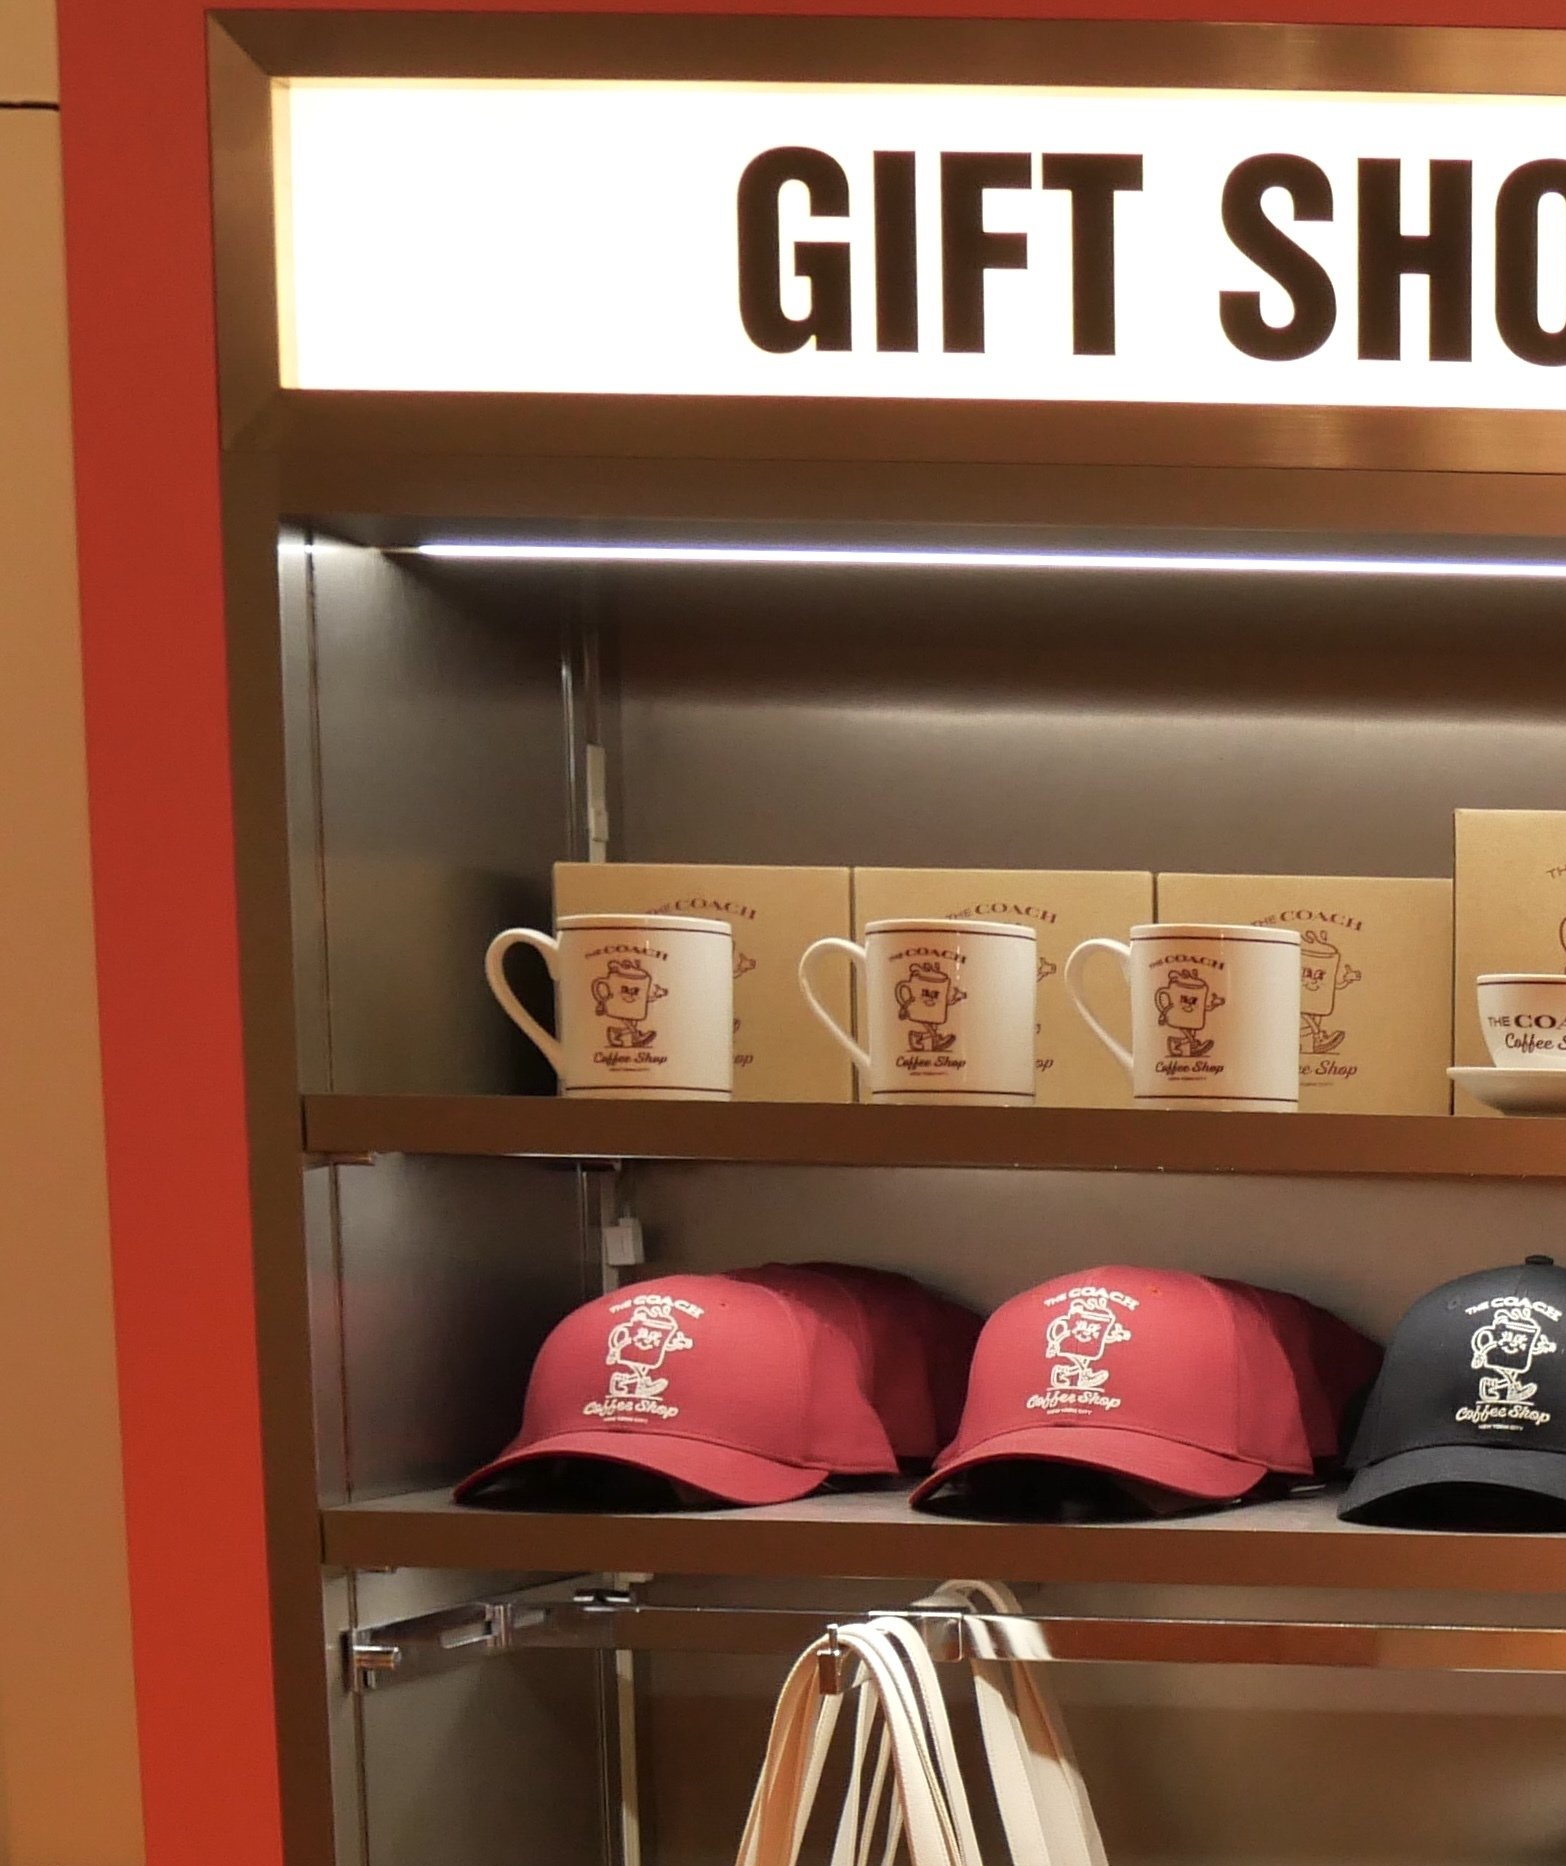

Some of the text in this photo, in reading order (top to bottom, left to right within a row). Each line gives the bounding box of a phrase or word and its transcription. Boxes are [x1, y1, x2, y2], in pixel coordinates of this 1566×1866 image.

[736, 146, 1144, 355] GIFT
[675, 898, 756, 920] COACH
[975, 903, 1057, 924] COACH
[1280, 909, 1362, 932] COACH
[603, 944, 668, 961] COACH
[905, 947, 966, 964] COACH
[1164, 954, 1225, 971] COACH
[1487, 1016, 1511, 1027] THE
[1504, 1032, 1554, 1053] Coffee
[593, 1051, 668, 1067] Coffee Shop
[895, 1055, 966, 1069] Coffee Shop
[1155, 1060, 1224, 1074] Coffee Shop
[1315, 1060, 1357, 1078] Shop
[609, 1295, 705, 1319] THE COACH
[1043, 1287, 1141, 1311] THE COACH
[1465, 1296, 1563, 1322] THE COACH
[583, 1399, 679, 1419] Coffee Shop
[1026, 1391, 1121, 1411] Coffee Shop
[1455, 1404, 1551, 1425] Coffee Shop
